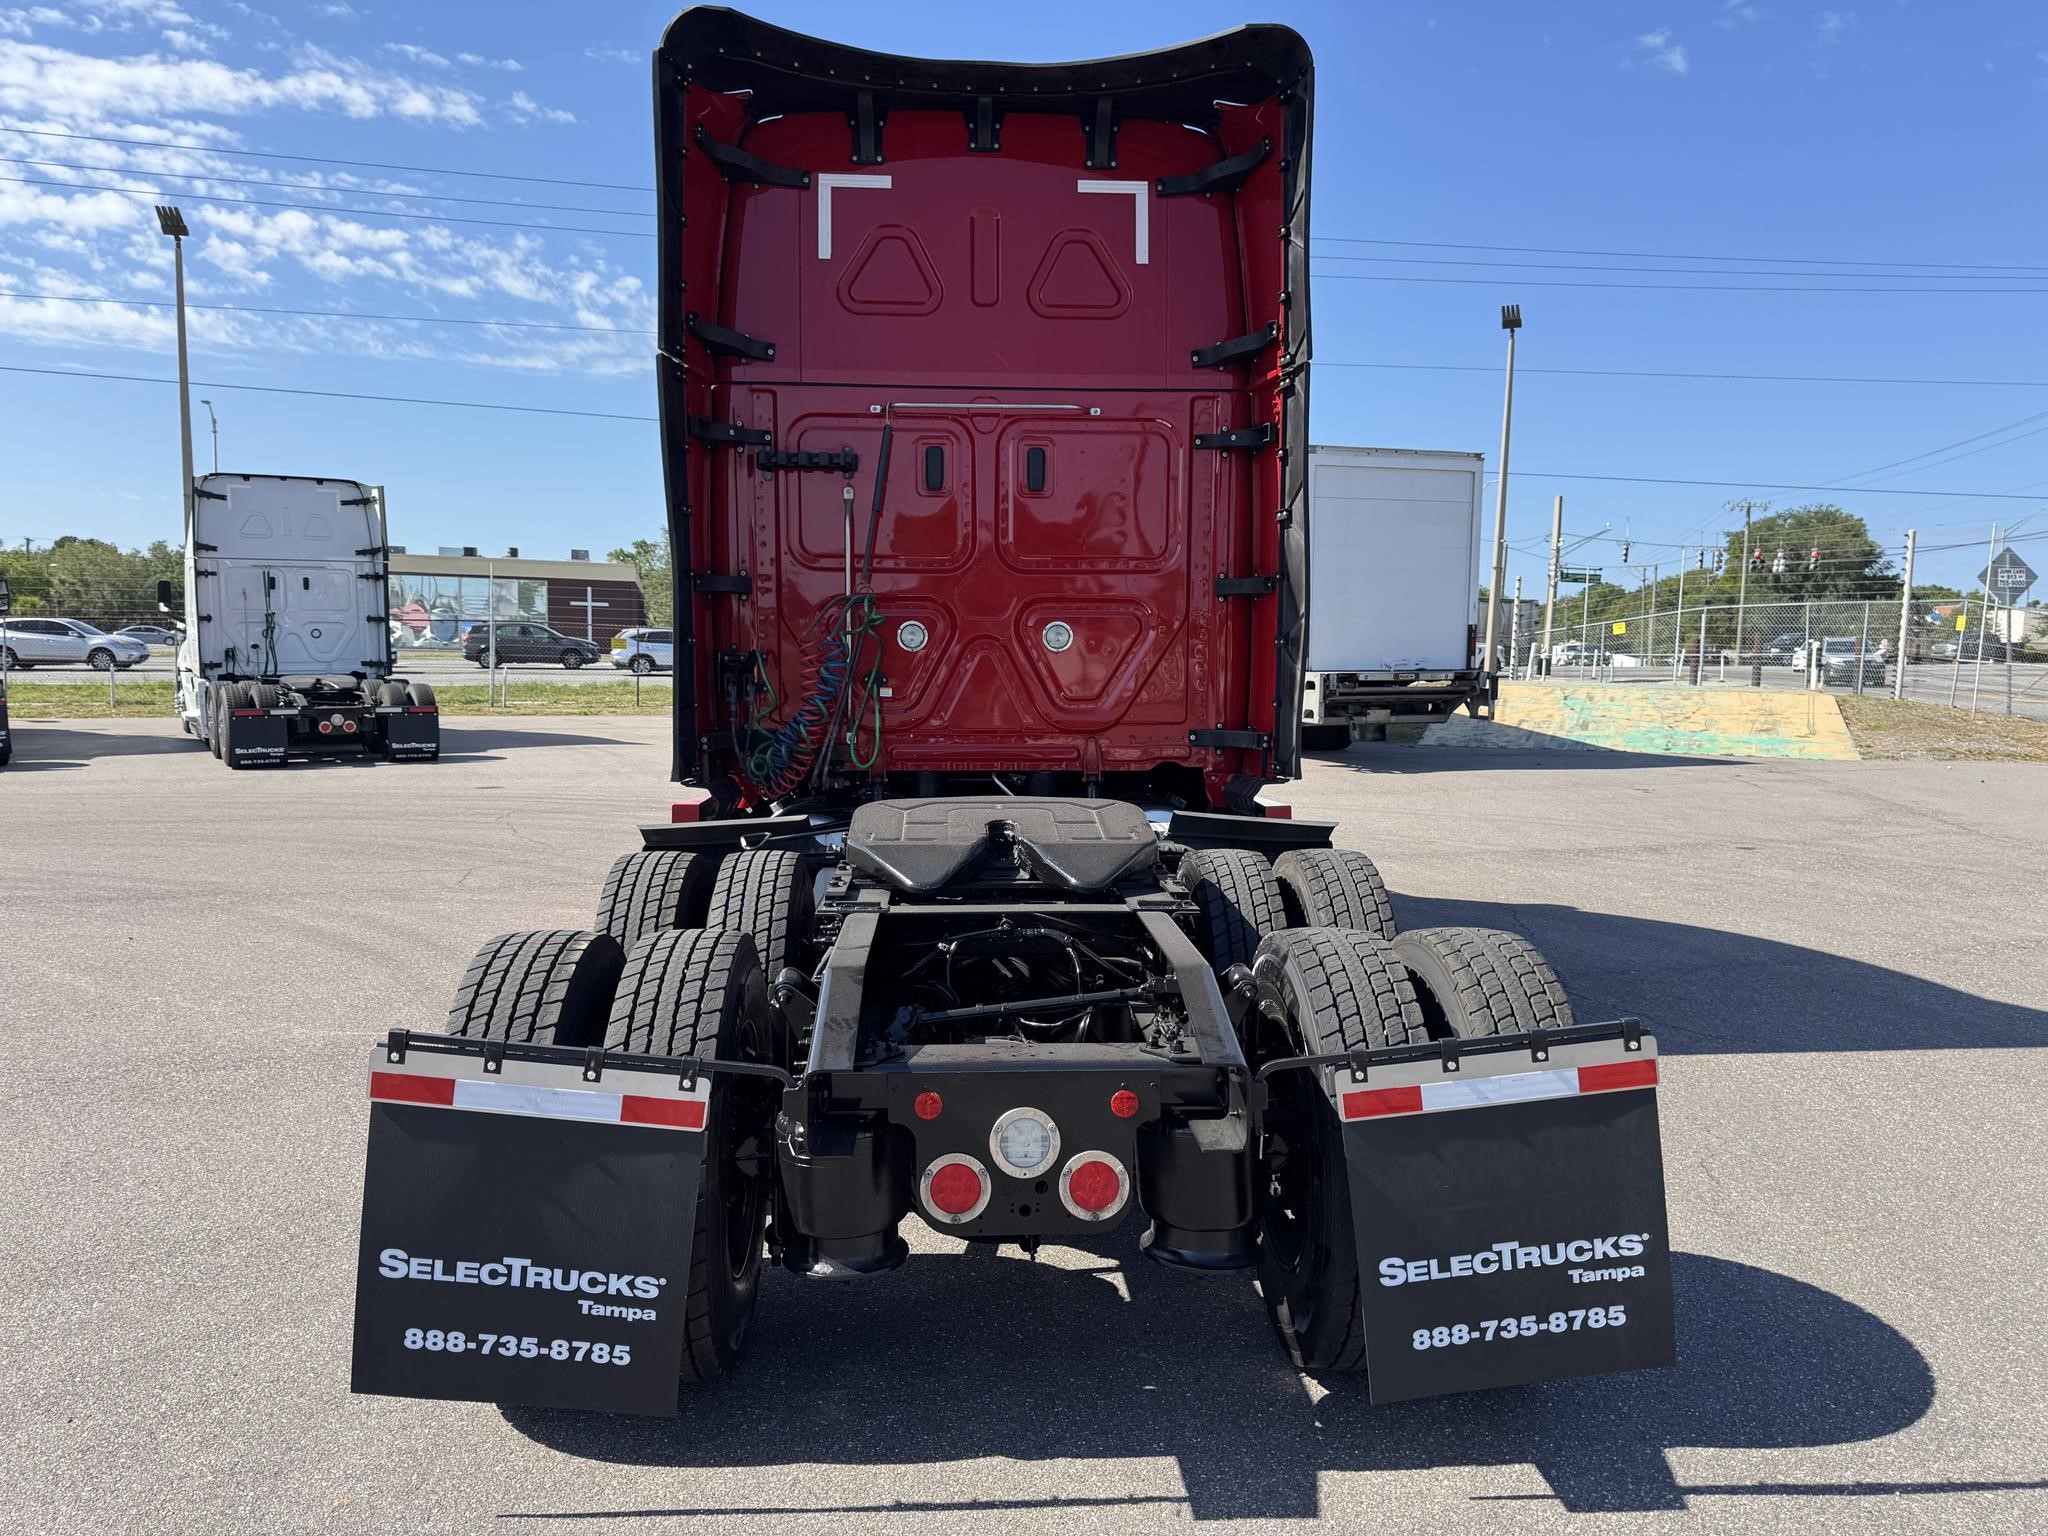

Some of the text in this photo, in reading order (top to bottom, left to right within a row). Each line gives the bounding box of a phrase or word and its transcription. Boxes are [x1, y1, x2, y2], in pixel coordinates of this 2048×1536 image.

[1567, 1265, 1645, 1284] Tampa
[577, 1299, 657, 1322] Tampa
[1412, 1304, 1627, 1351] 888-735-8785
[403, 1327, 631, 1366] 888-735-8785
